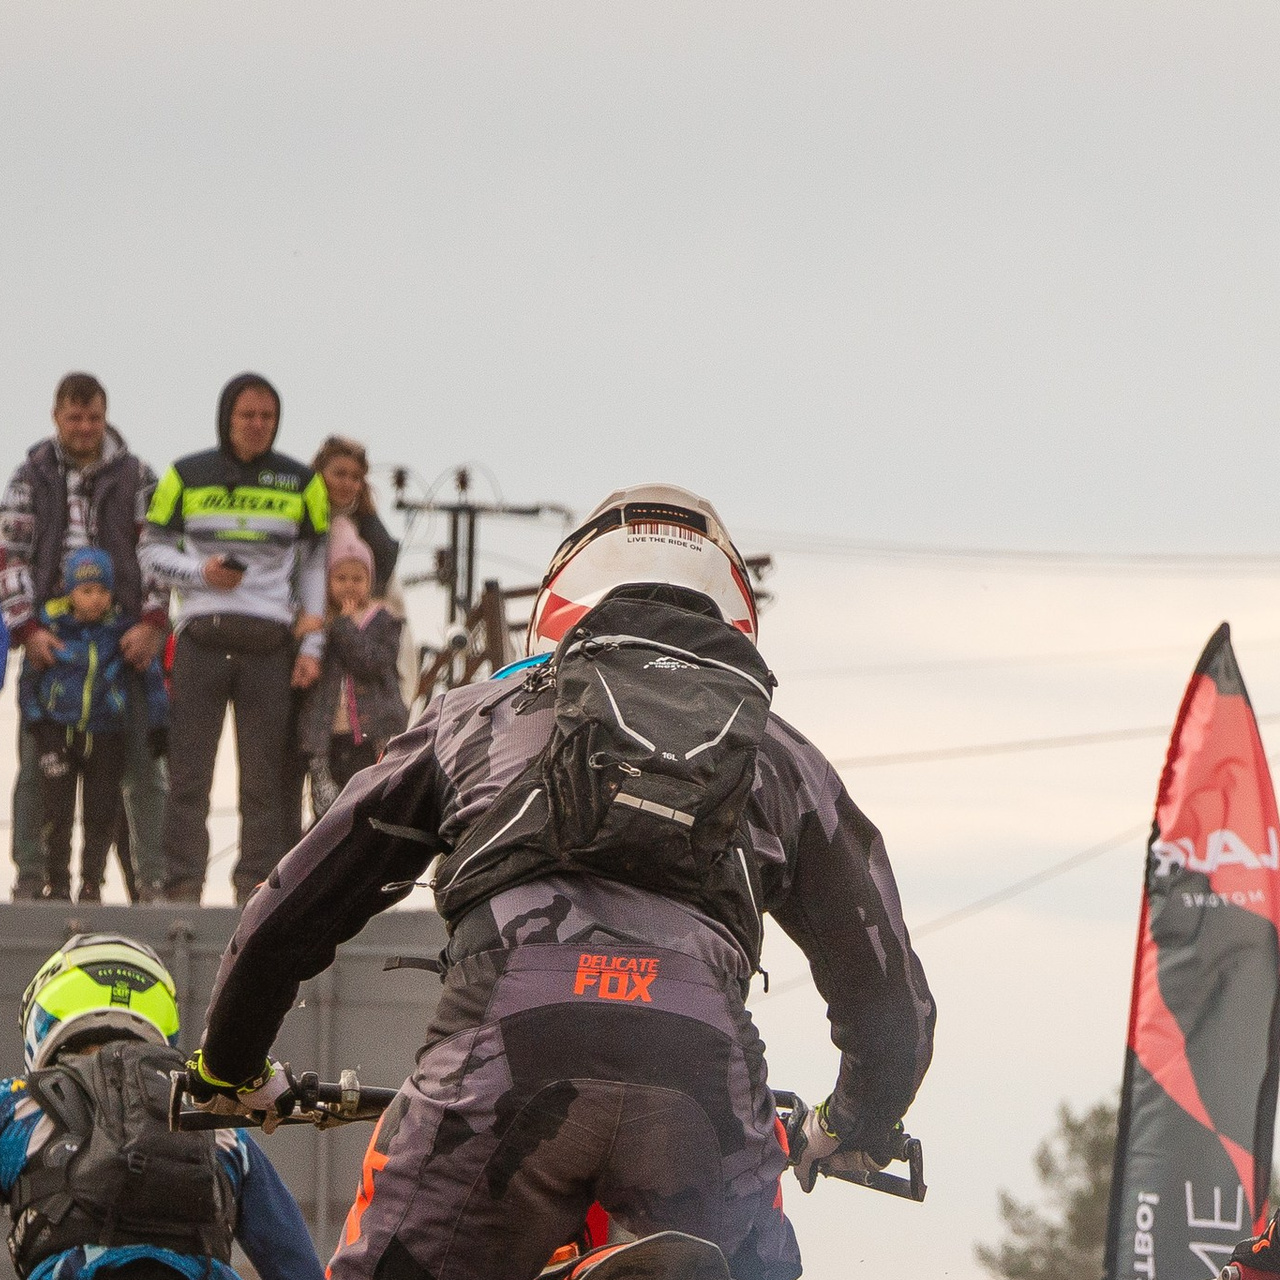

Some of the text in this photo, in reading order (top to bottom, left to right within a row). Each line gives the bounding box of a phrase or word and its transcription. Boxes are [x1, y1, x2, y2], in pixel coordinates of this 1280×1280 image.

[626, 536, 703, 553] LIVE THE RIDE ON
[661, 751, 679, 762] 16L
[578, 953, 661, 973] DELICATE
[573, 966, 658, 1003] FOX
